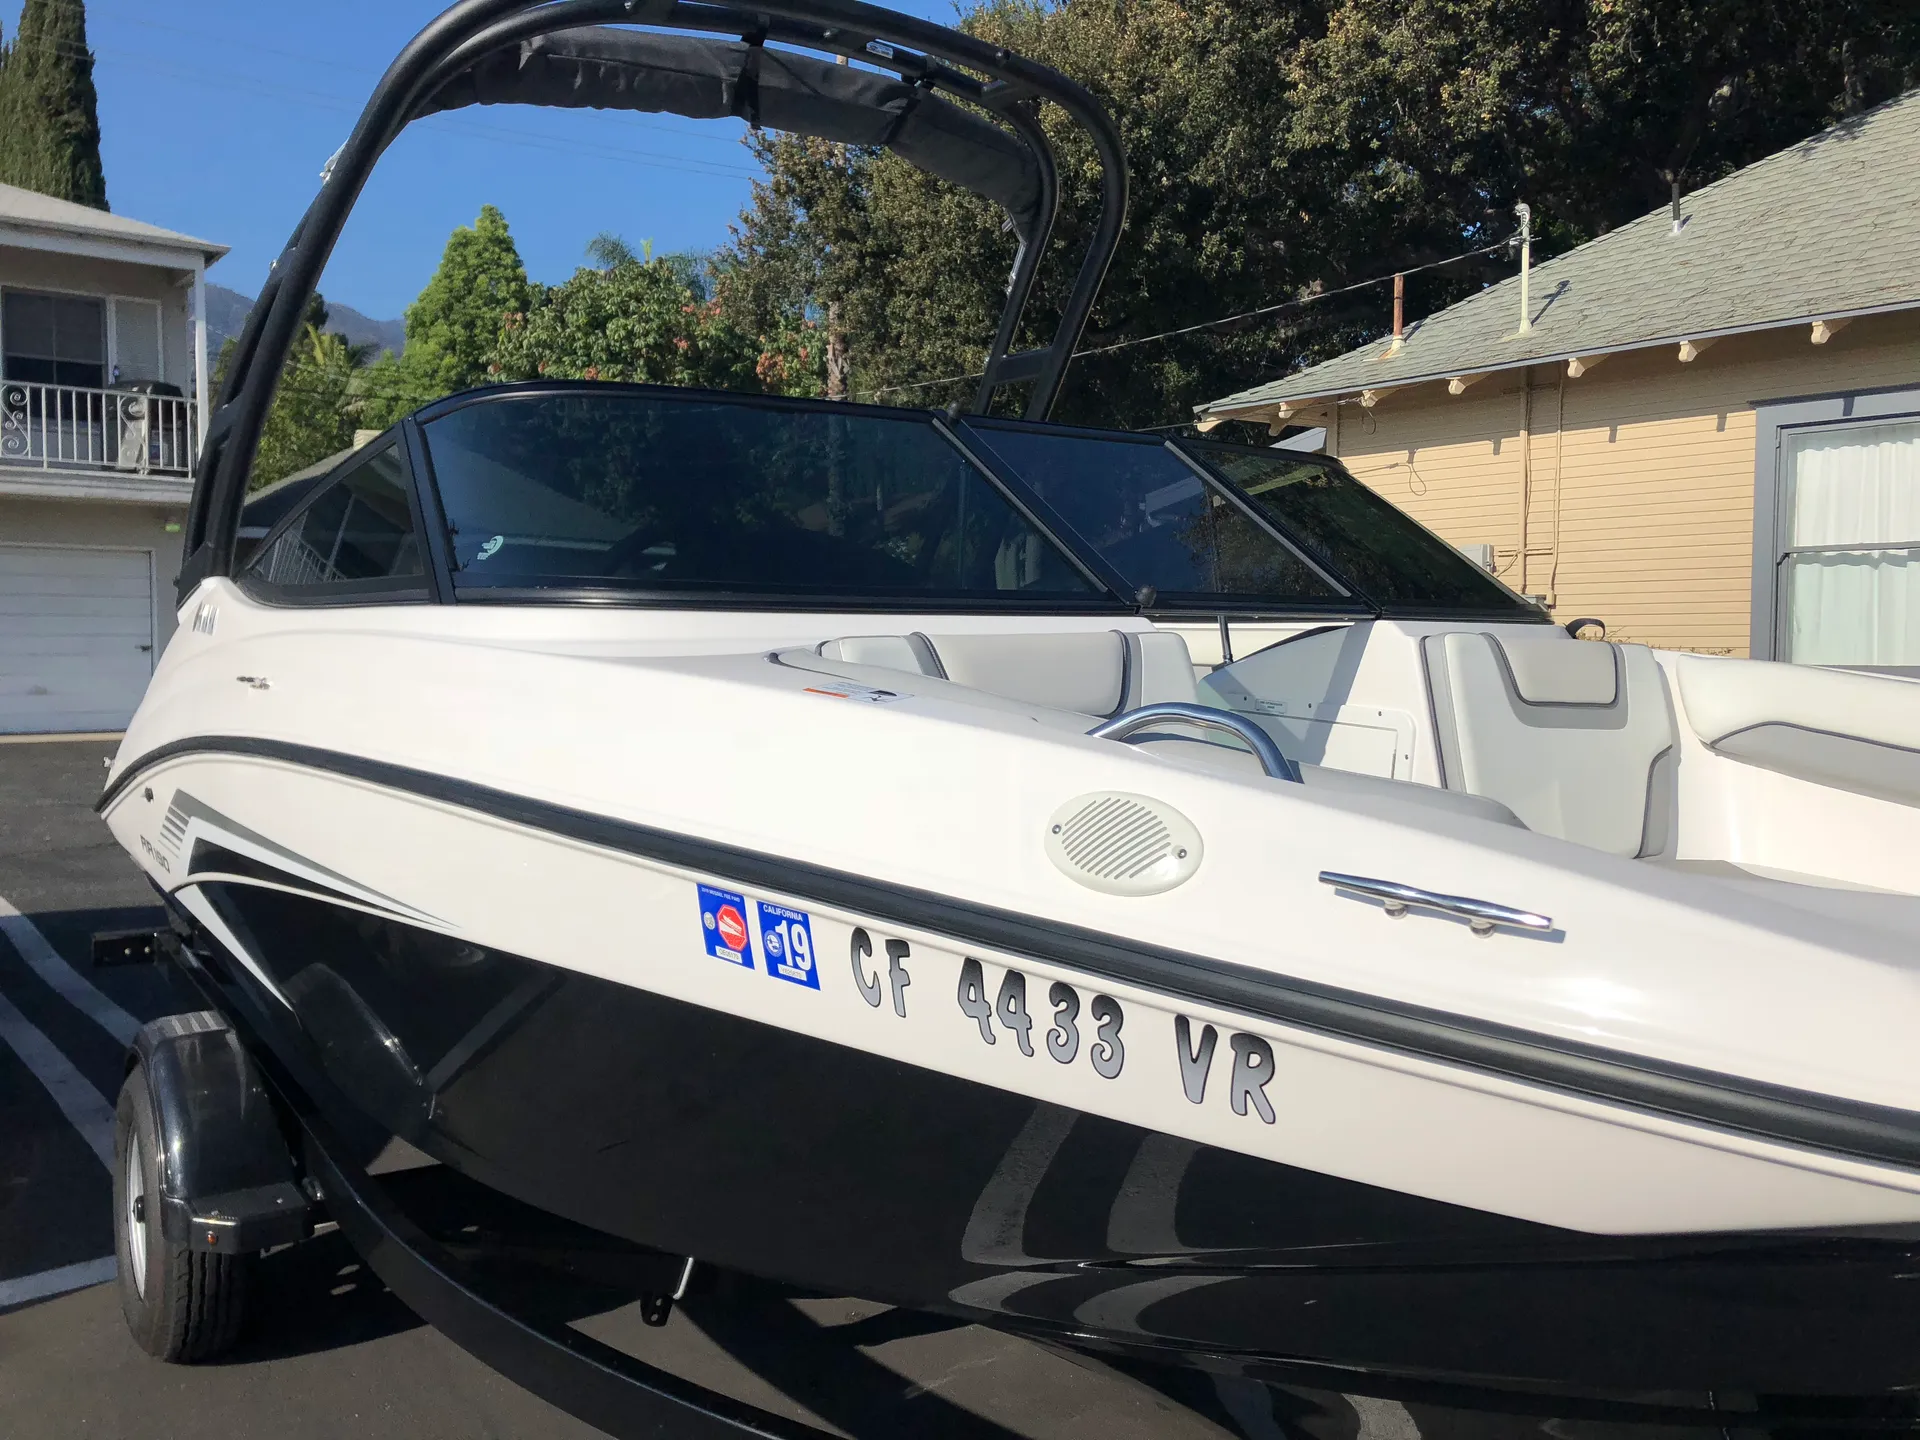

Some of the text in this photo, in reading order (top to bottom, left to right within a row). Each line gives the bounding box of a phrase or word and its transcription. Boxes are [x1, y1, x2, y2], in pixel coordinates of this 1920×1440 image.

[763, 904, 803, 921] CALIFORNIA
[775, 920, 812, 971] 19
[850, 926, 1276, 1125] CF 4433 VR
